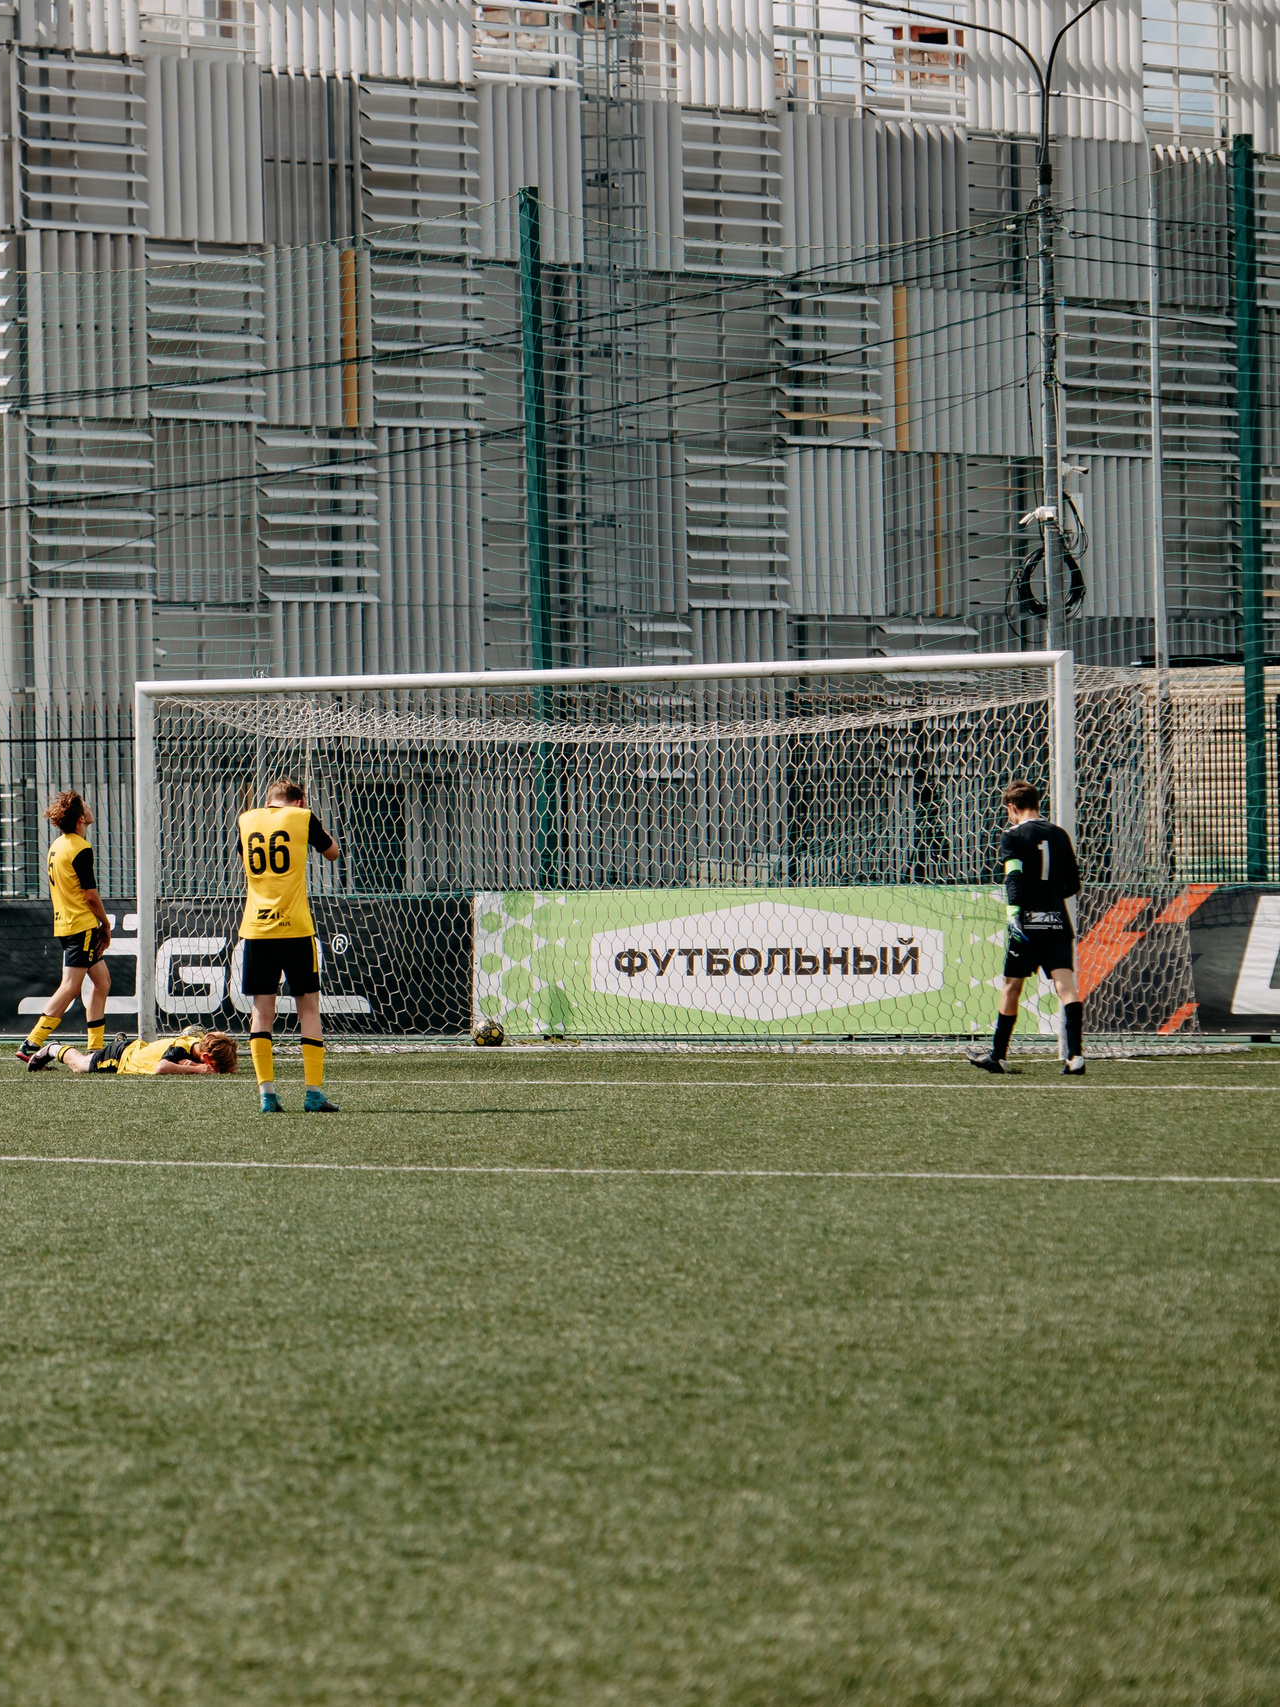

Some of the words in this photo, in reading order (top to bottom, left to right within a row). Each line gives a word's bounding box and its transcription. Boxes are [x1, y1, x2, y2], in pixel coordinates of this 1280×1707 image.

[248, 830, 290, 875] 66
[1037, 840, 1051, 881] 1
[614, 937, 920, 977] ФУТБОЛЬНЫЙ
